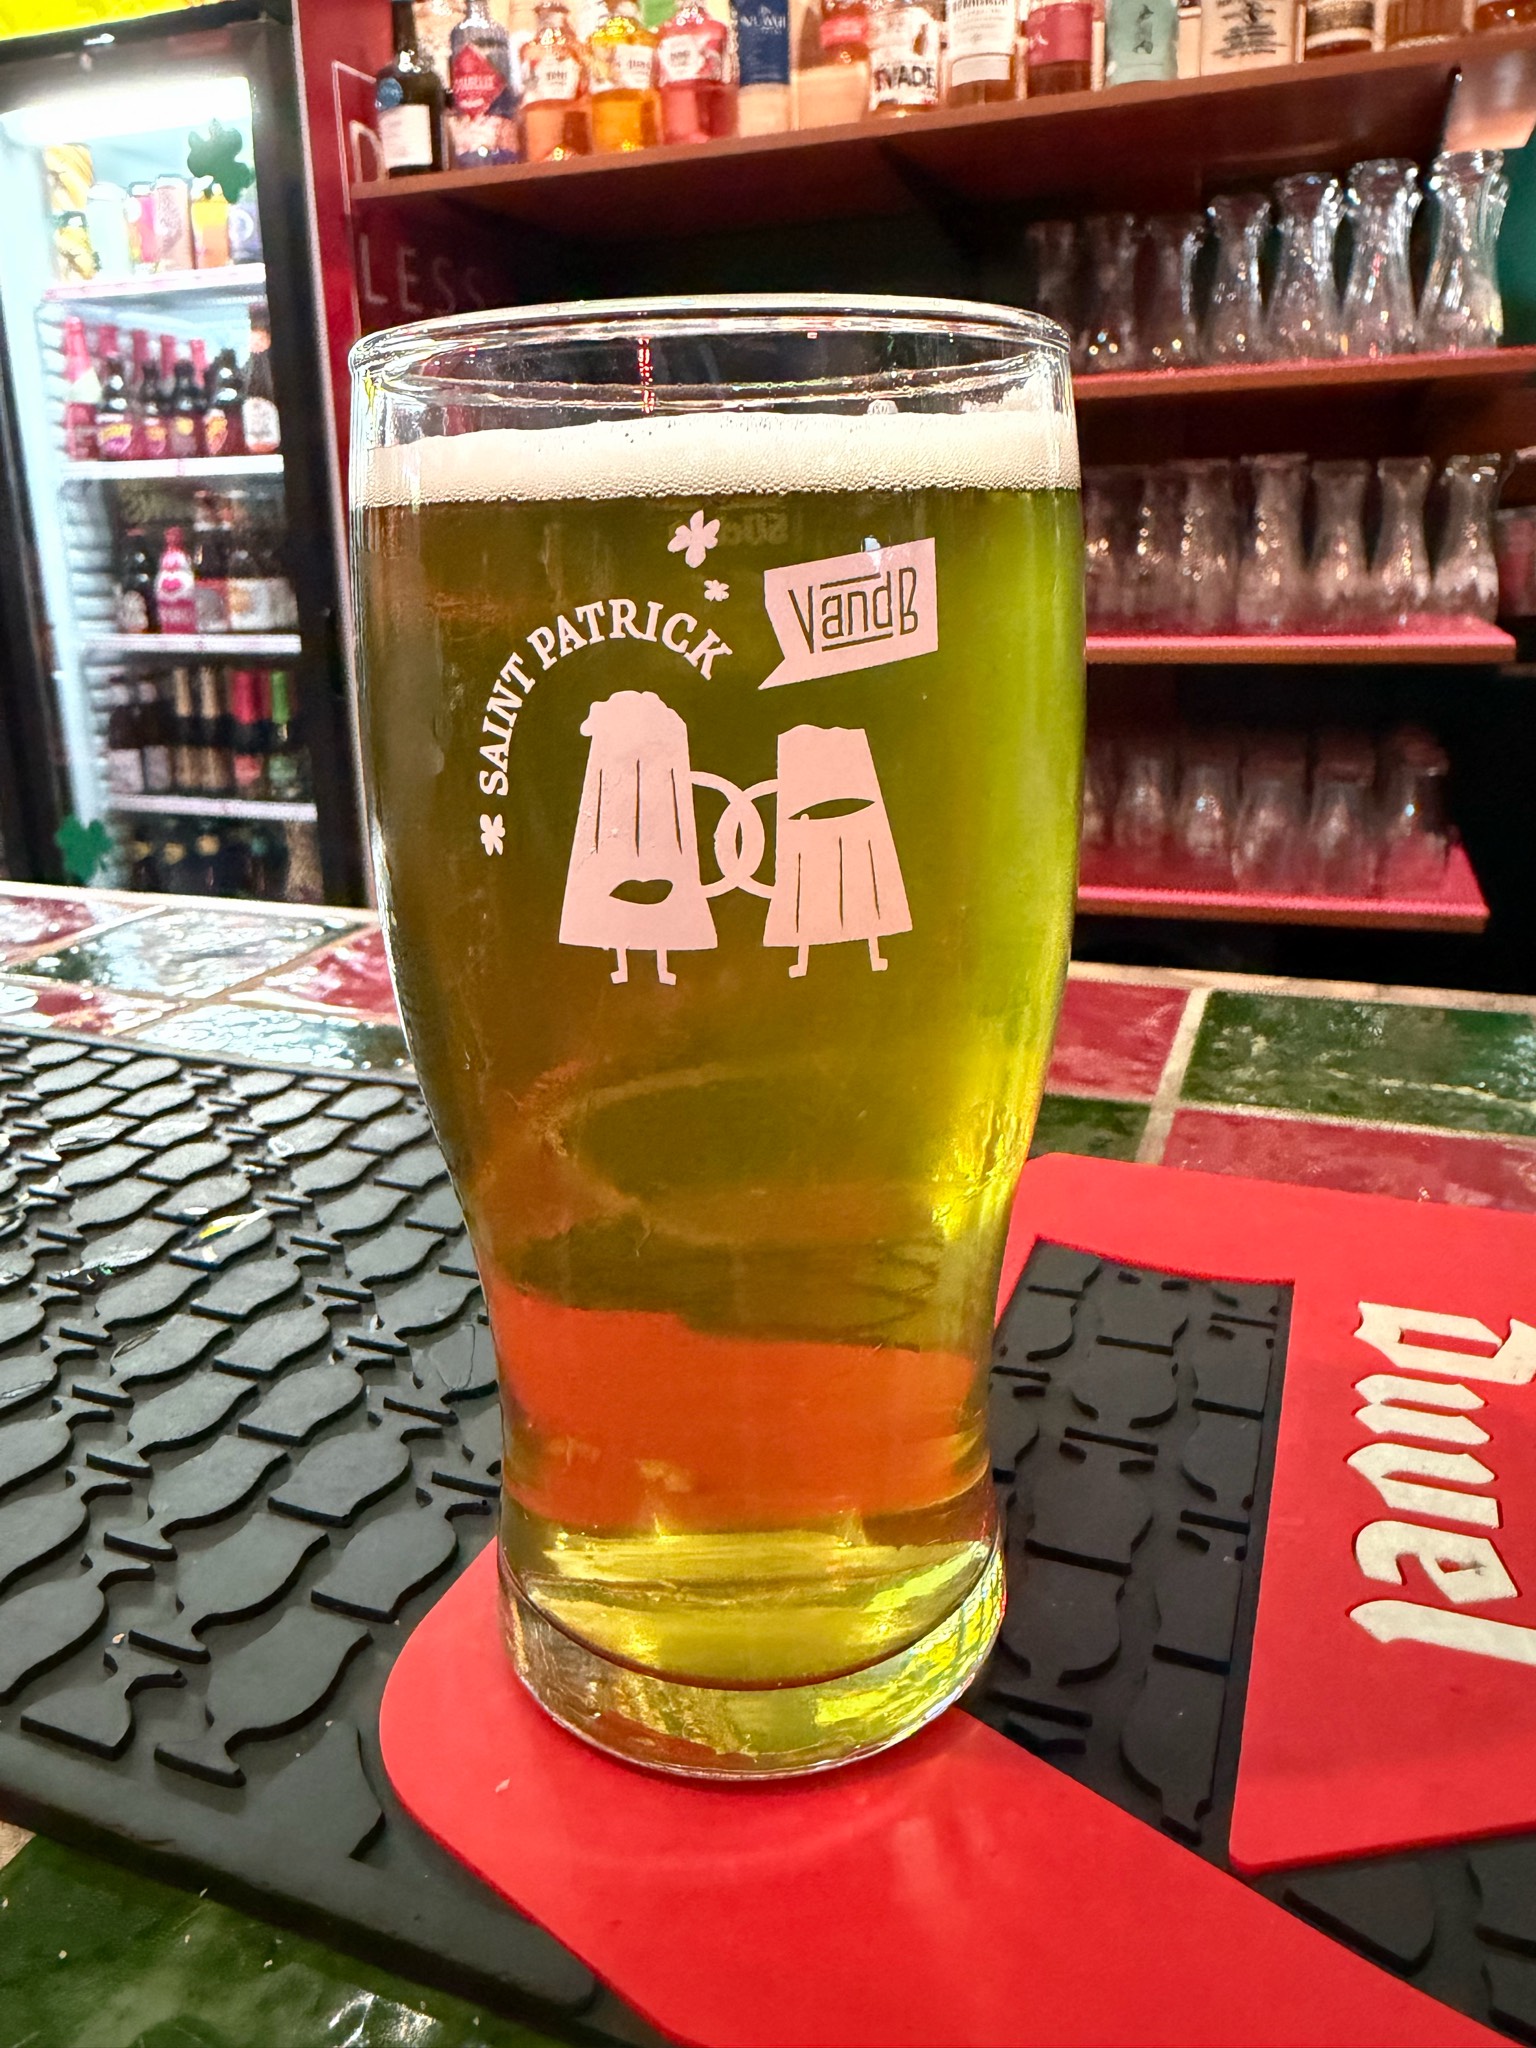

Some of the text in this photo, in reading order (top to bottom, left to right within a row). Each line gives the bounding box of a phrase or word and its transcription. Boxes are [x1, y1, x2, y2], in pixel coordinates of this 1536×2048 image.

[478, 597, 733, 797] SAINT PATRICK
[1347, 1300, 1536, 1667] Duvel
